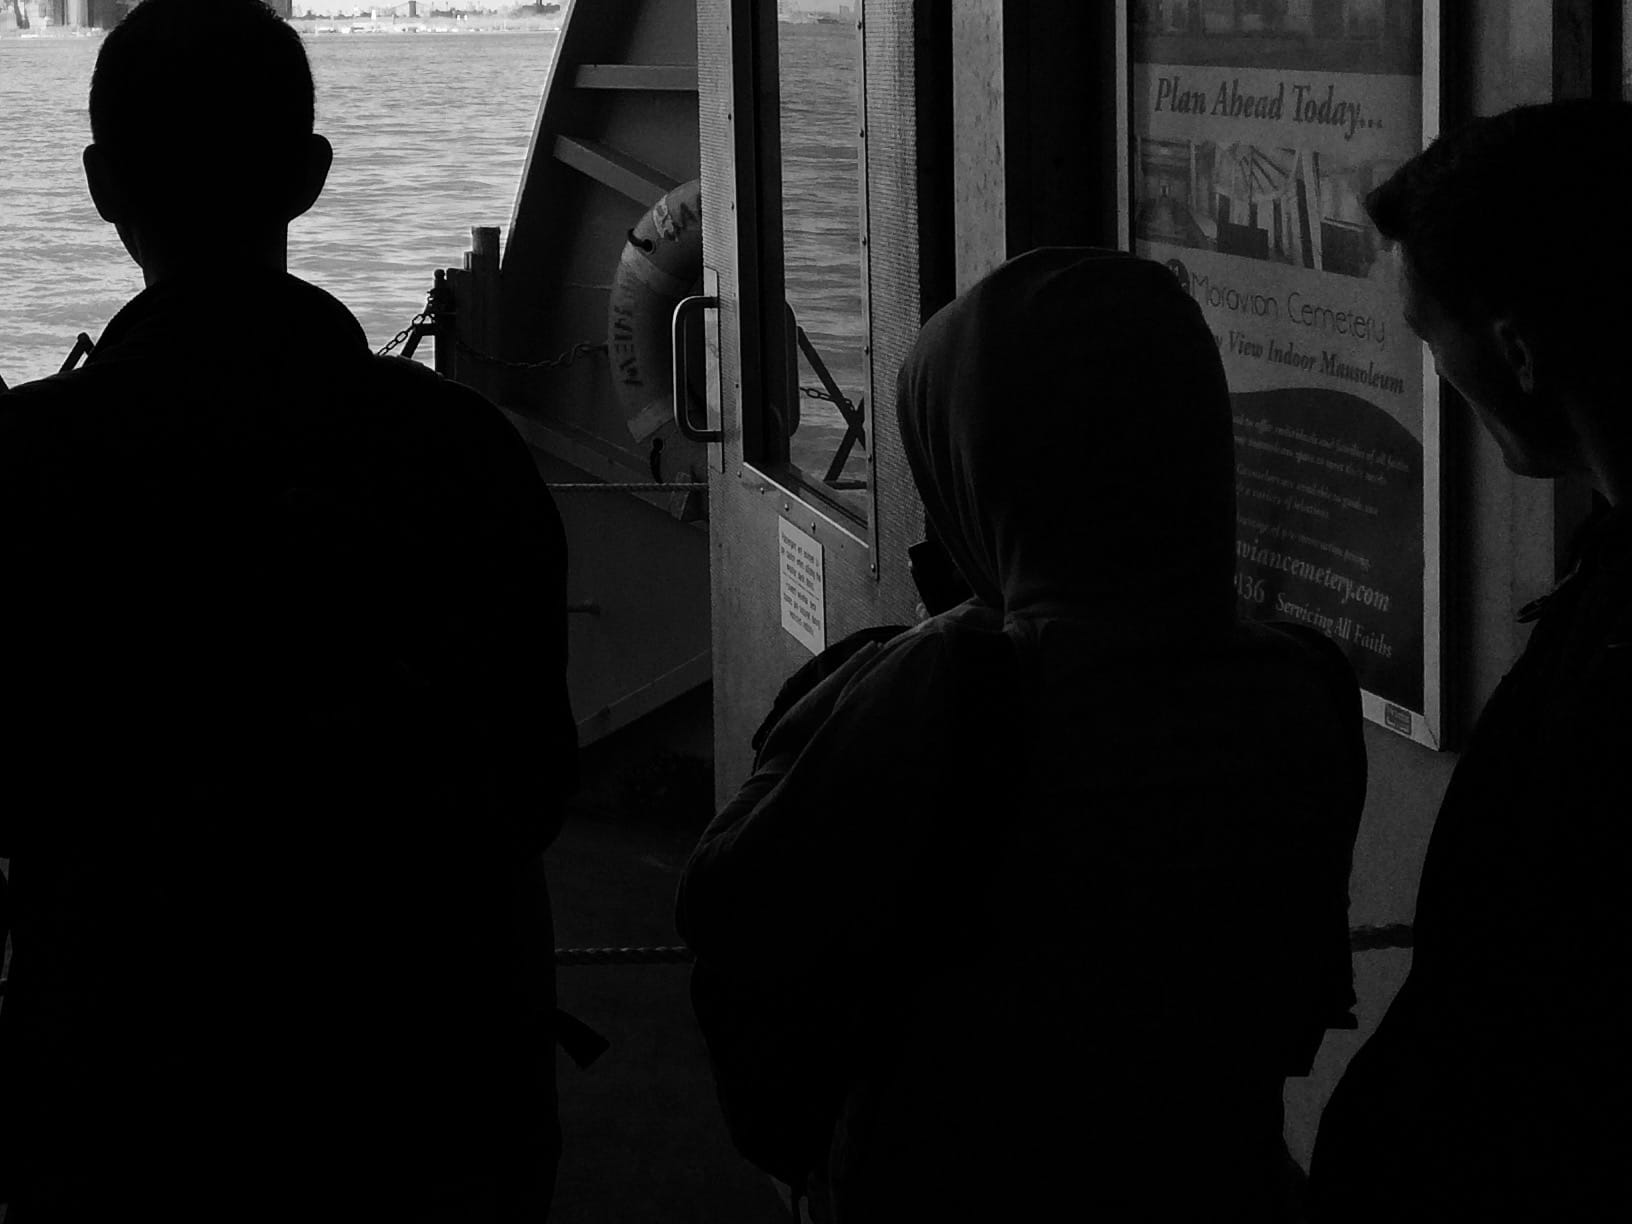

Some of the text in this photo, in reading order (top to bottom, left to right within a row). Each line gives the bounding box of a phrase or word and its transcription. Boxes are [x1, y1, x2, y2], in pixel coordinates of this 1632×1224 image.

[1154, 78, 1384, 136] Plan Ahead Today...
[1192, 273, 1278, 321] Moravian
[1287, 292, 1385, 350] Cemetery
[1229, 330, 1265, 359] View
[1268, 340, 1317, 373] Indoor
[1319, 351, 1406, 395] Mausoleum
[1276, 591, 1333, 639] Servicing
[1334, 614, 1352, 643] All
[1353, 624, 1394, 661] Faiths
